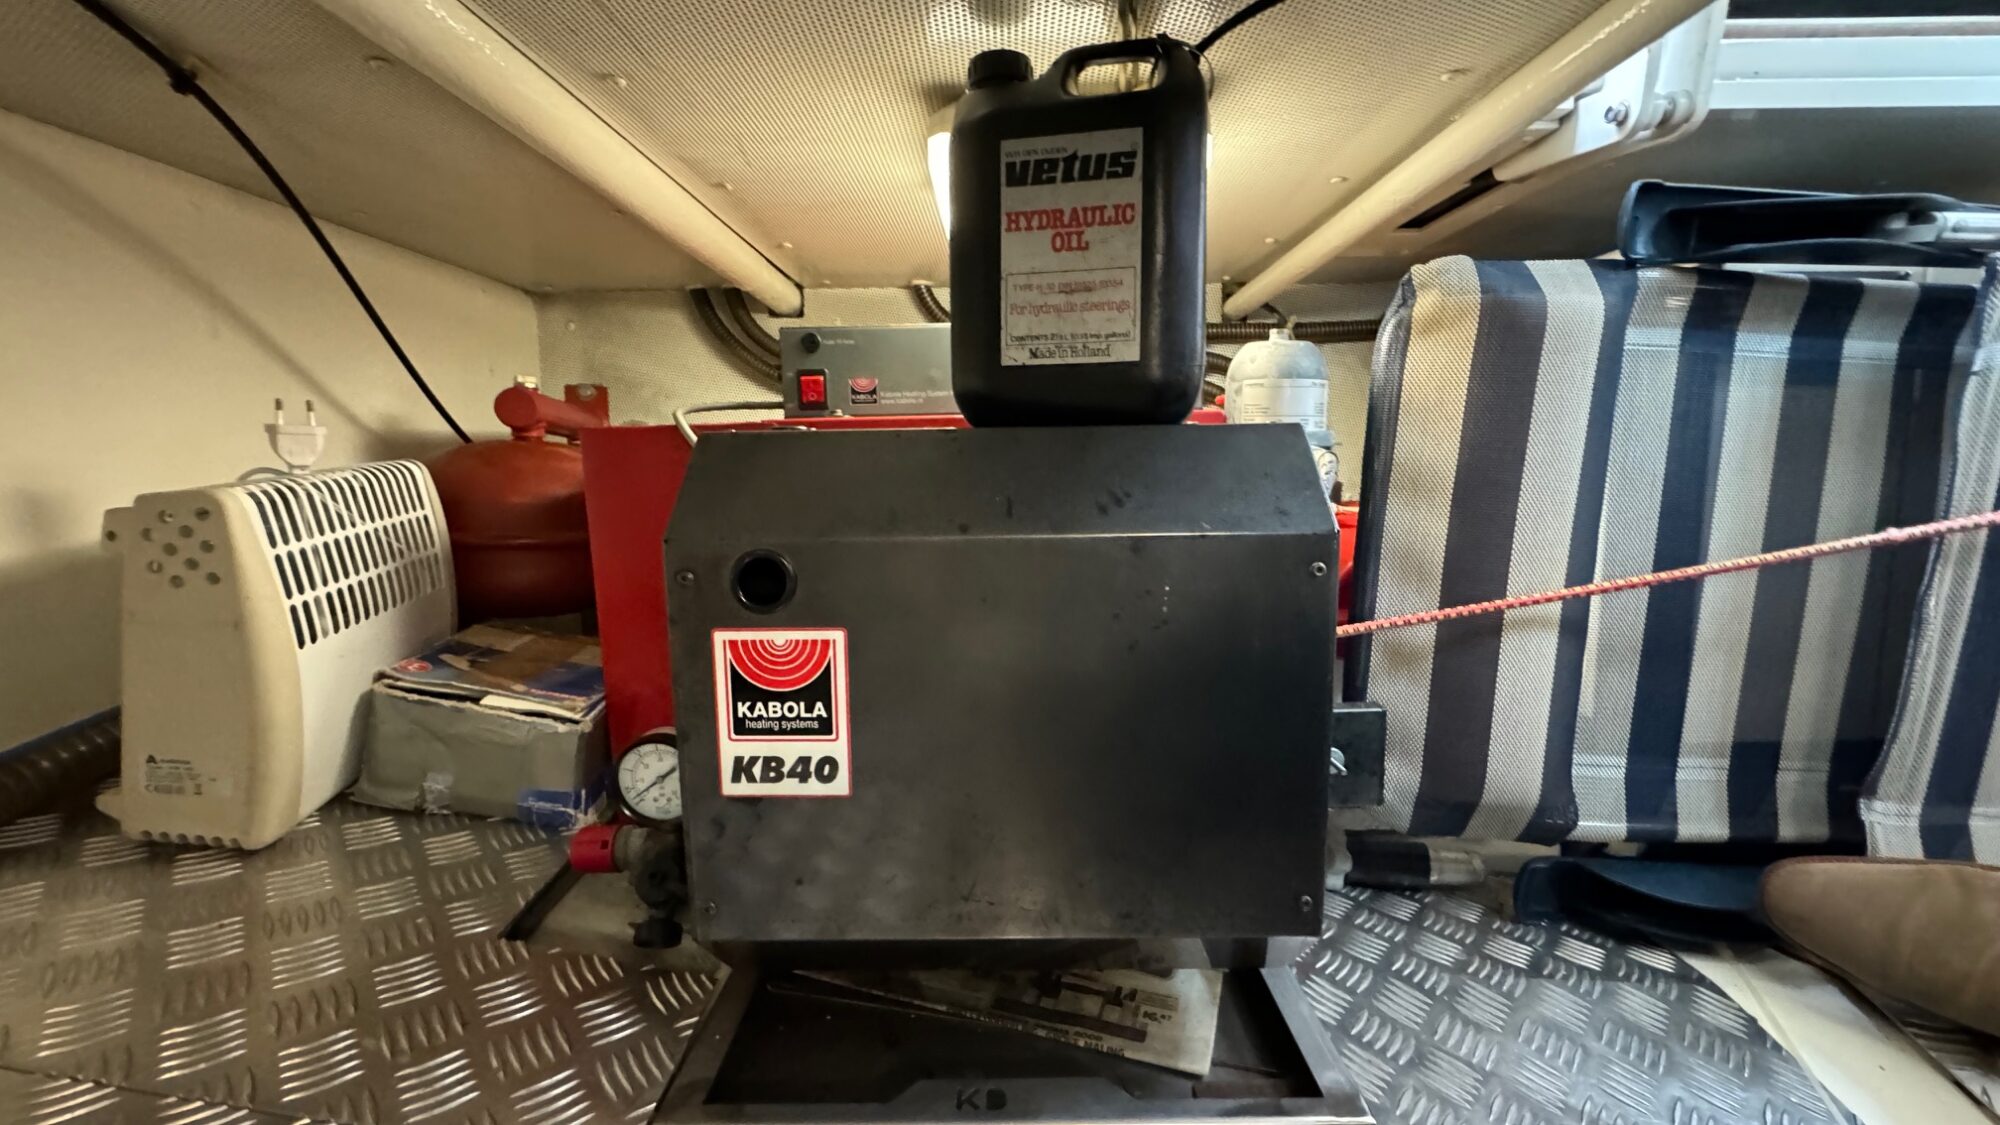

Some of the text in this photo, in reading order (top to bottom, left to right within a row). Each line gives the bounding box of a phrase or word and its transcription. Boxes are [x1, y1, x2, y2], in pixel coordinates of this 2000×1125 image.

[1005, 150, 1138, 187] vetus
[1005, 202, 1136, 233] HYDRAULIC
[1051, 230, 1090, 253] OIL
[1009, 299, 1131, 317] For hydraulic steerings
[1029, 347, 1057, 360] Made
[1070, 344, 1112, 358] Holland
[737, 701, 828, 719] KABOLA
[745, 718, 819, 732] heating systems
[731, 755, 839, 785] KB40
